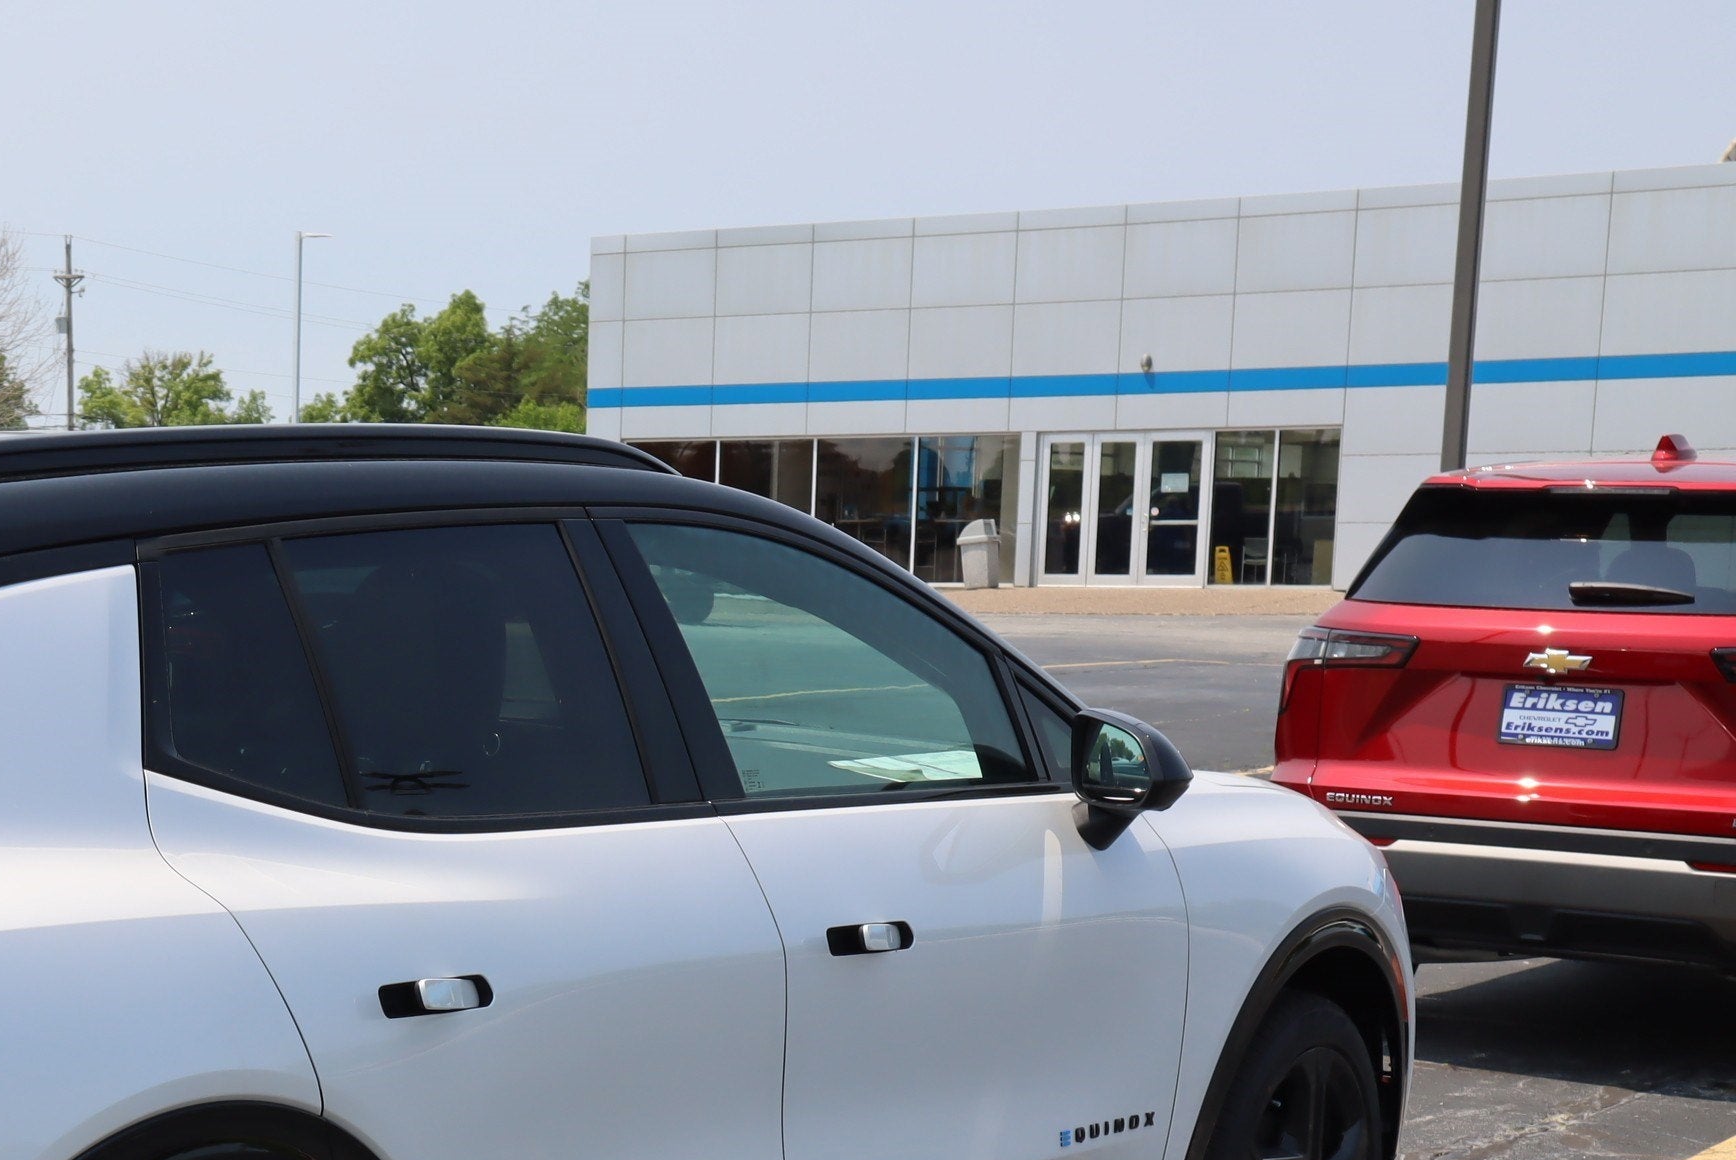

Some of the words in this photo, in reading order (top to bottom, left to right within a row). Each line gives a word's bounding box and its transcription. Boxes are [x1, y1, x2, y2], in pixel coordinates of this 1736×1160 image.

[1509, 692, 1613, 713] Eriksen
[1519, 714, 1562, 723] CHEVROLET
[1504, 721, 1610, 738] Eriksens.com
[1326, 792, 1394, 806] EQUINOX
[1060, 1111, 1156, 1147] EQUINOX
